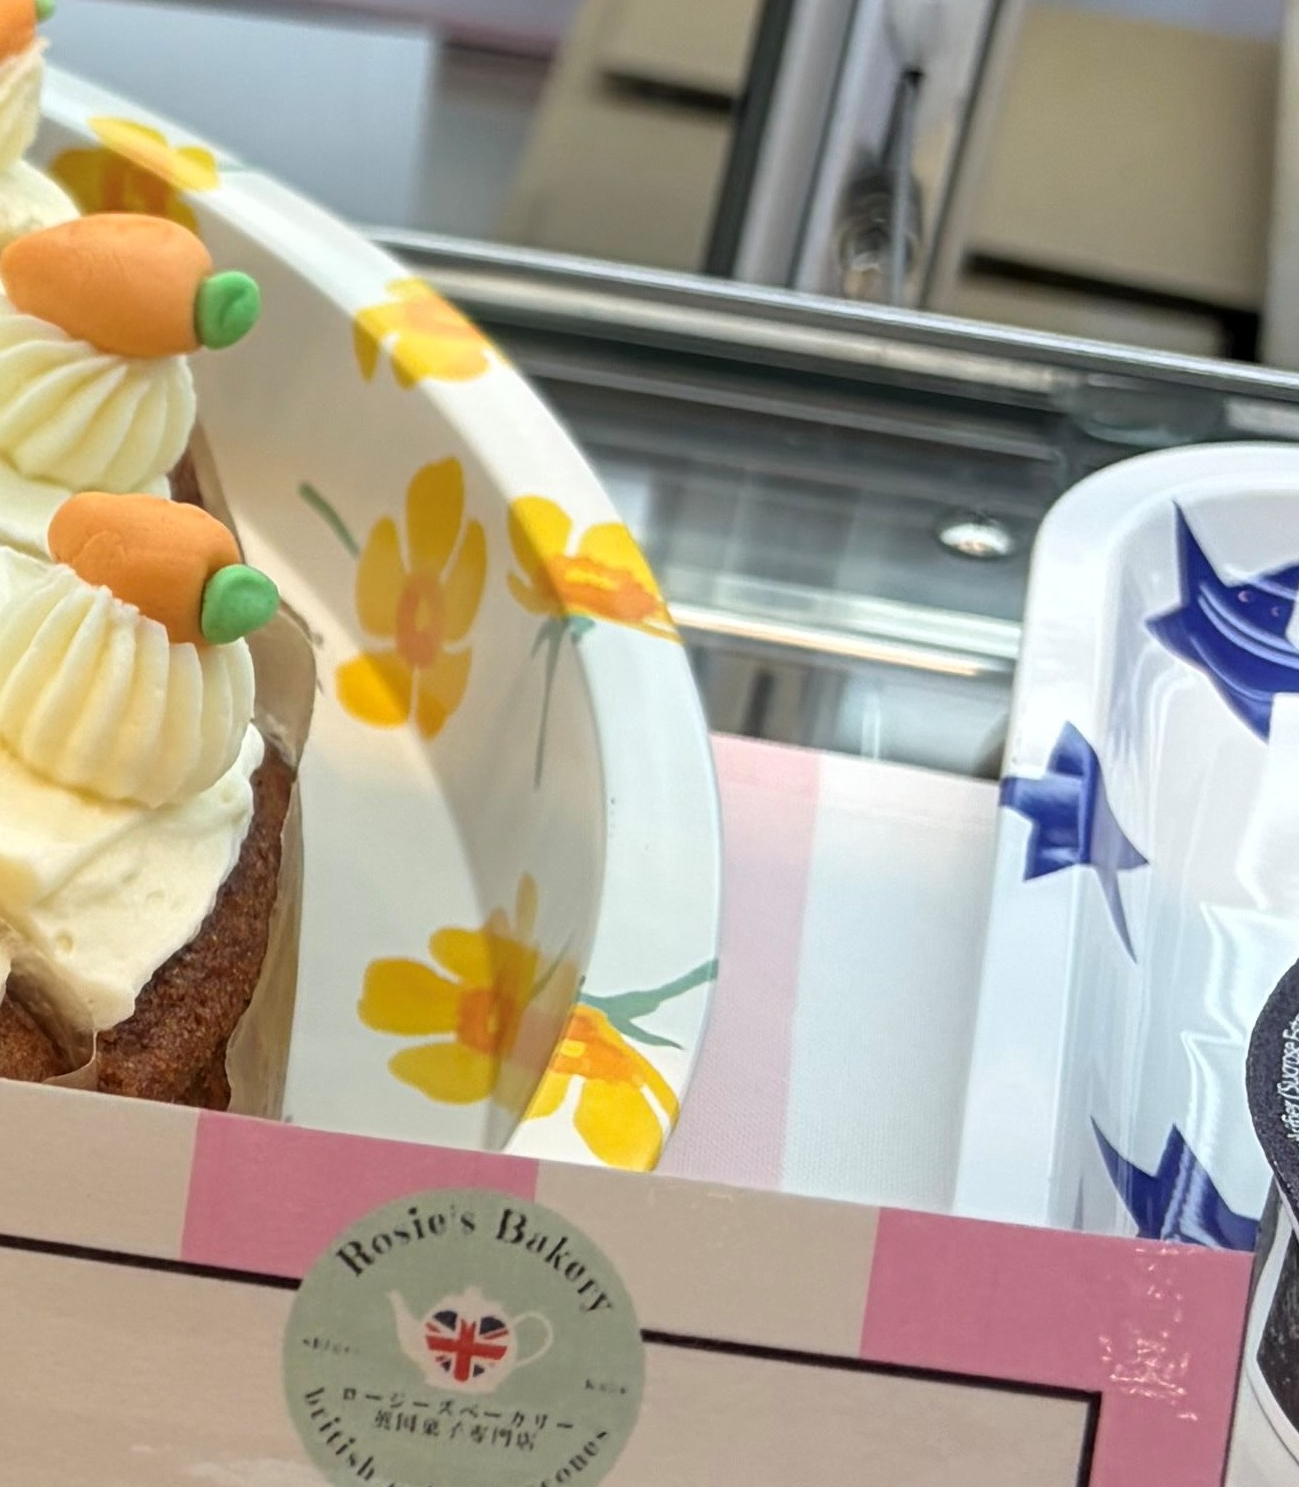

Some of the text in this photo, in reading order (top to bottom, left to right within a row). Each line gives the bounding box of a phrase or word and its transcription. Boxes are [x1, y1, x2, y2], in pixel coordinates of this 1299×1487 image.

[335, 1204, 613, 1314] Rosie's Bakery
[304, 1385, 377, 1483] british
